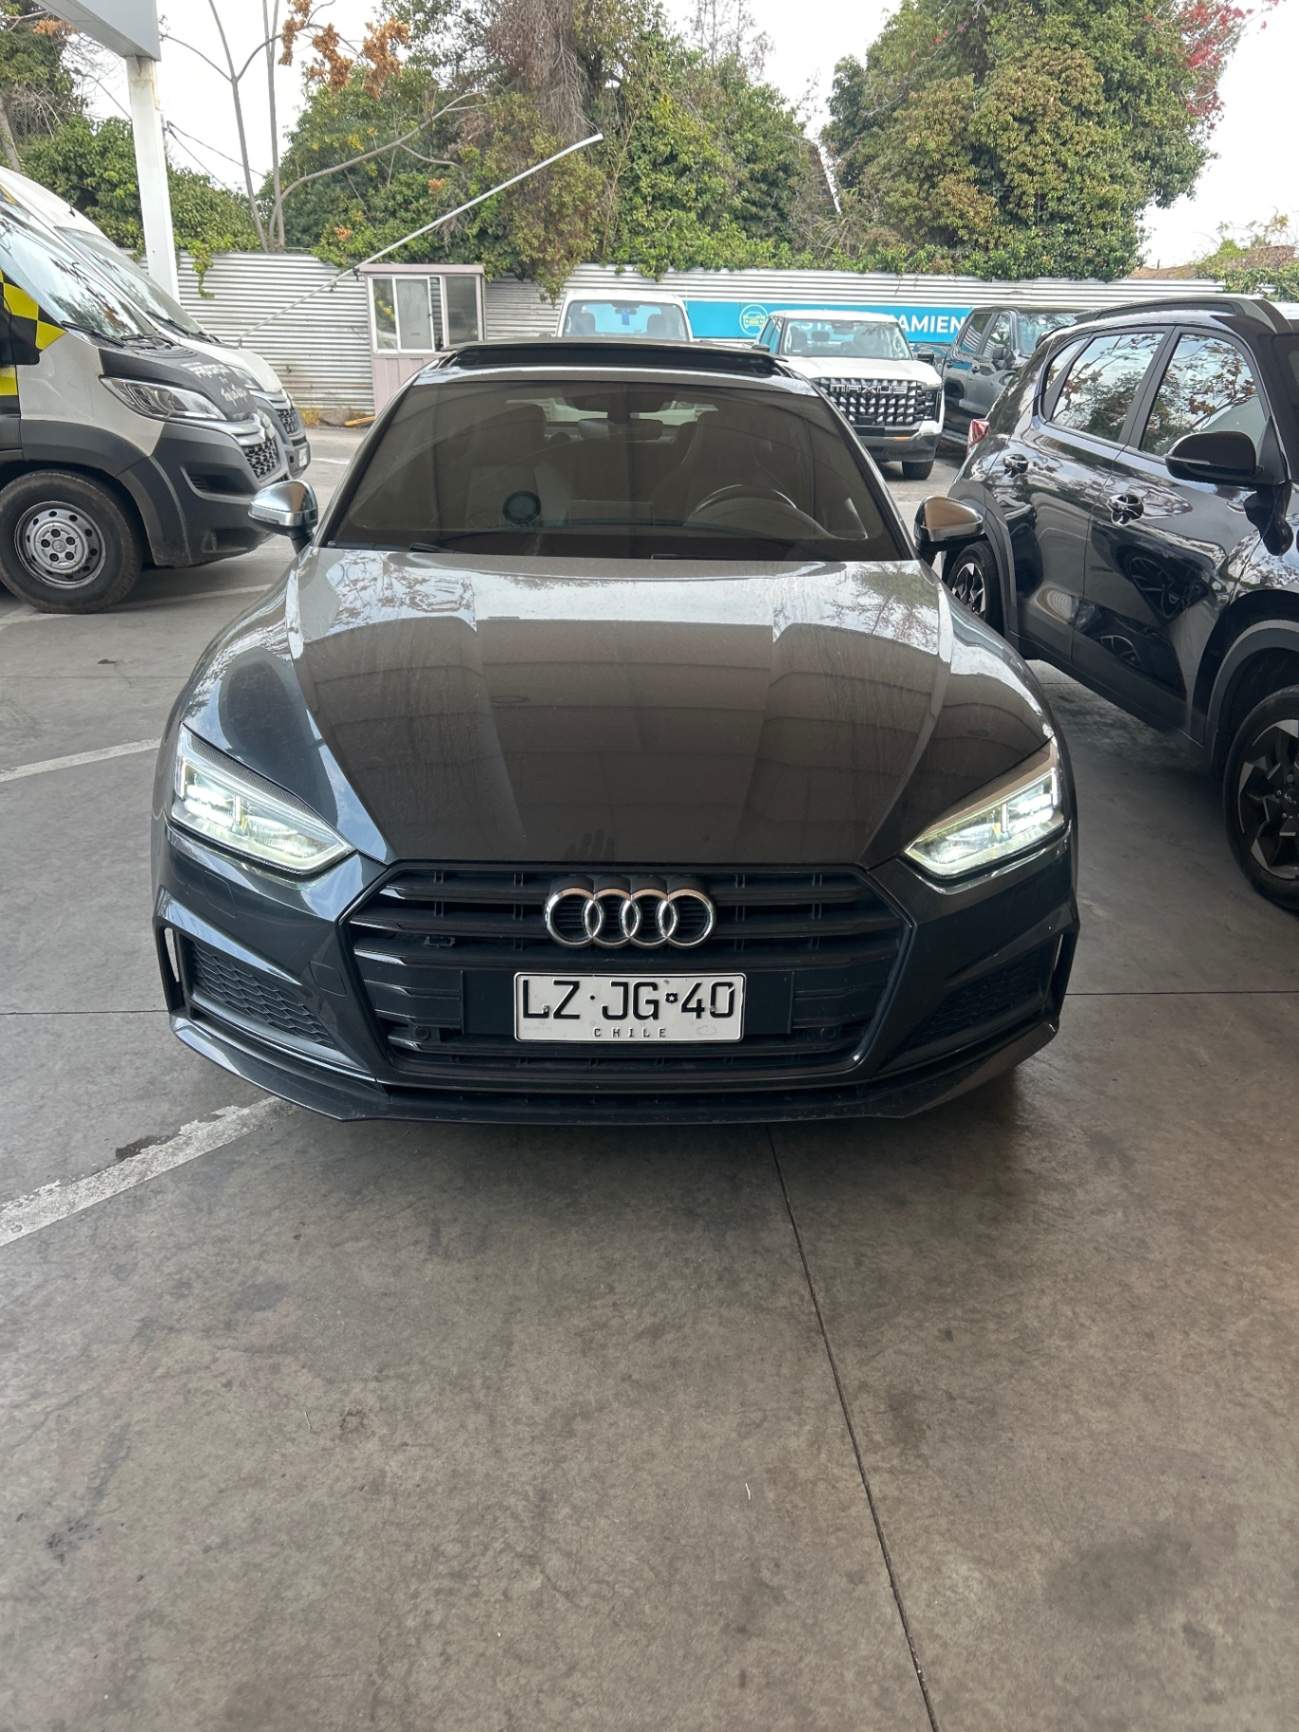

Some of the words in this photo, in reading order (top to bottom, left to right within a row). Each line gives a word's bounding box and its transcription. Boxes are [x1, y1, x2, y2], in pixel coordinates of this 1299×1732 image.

[898, 314, 966, 334] AMIEN
[829, 384, 908, 394] MAXUS
[594, 1028, 667, 1038] CHILE
